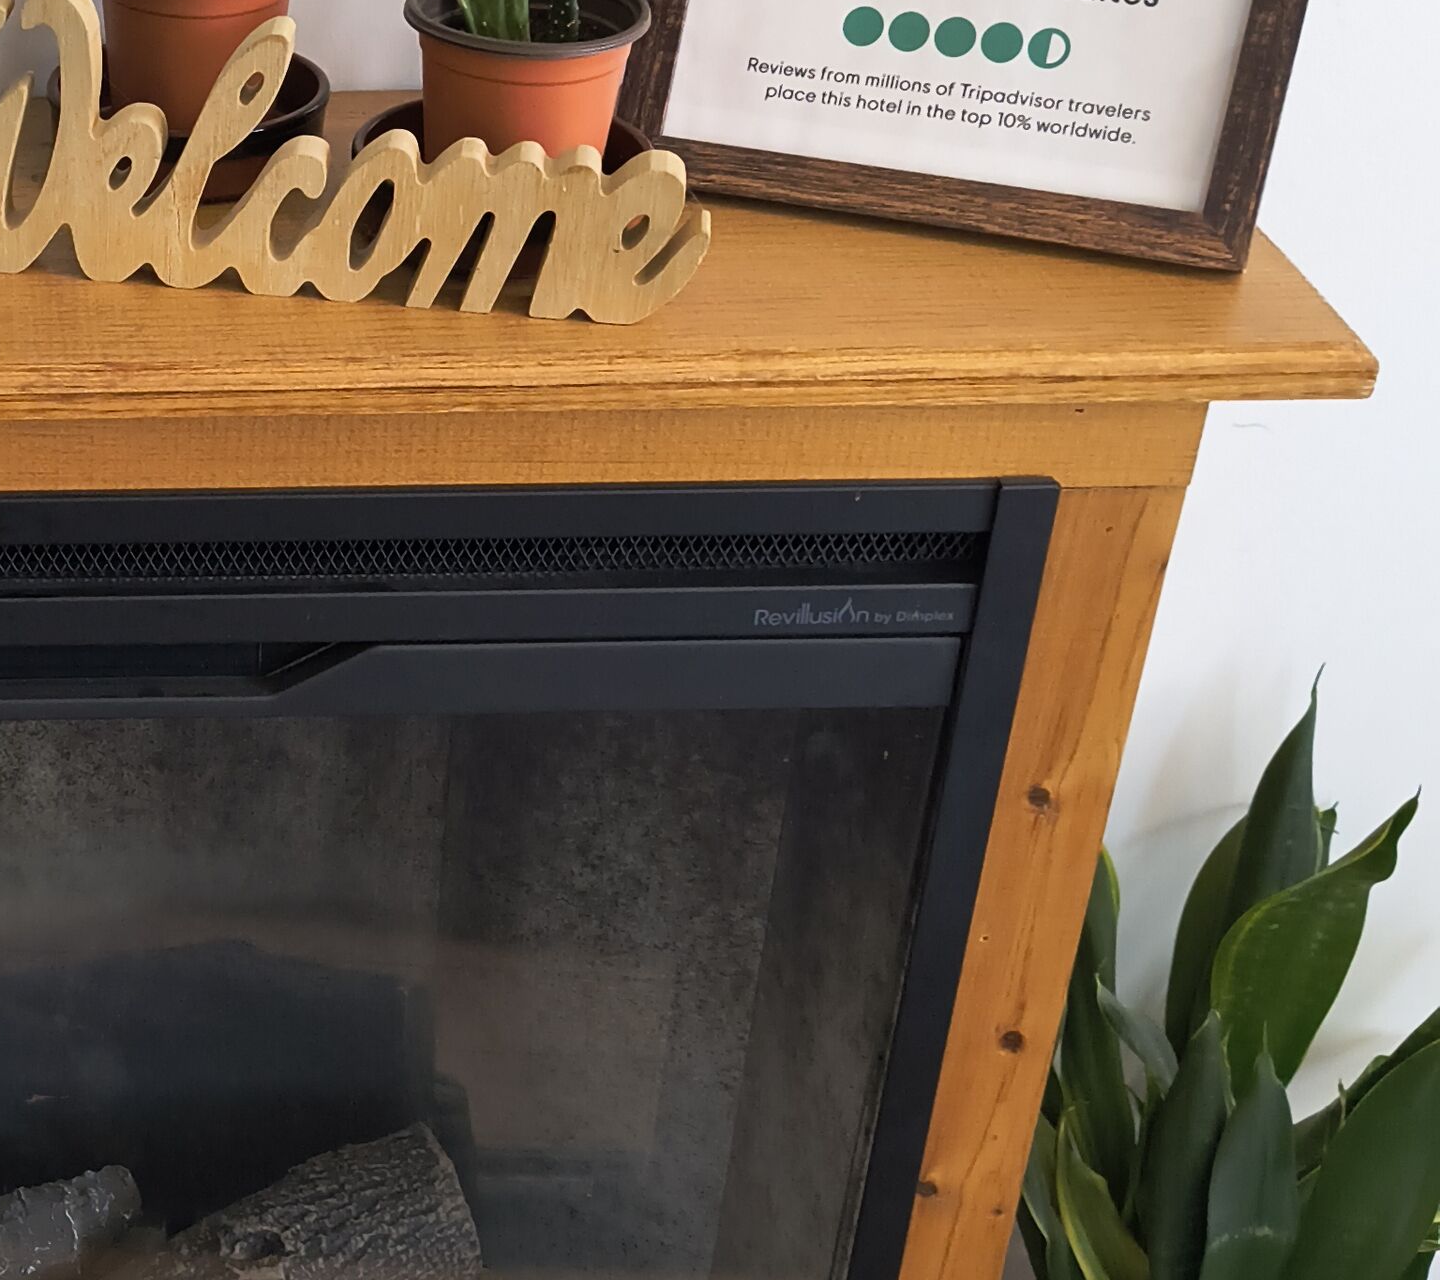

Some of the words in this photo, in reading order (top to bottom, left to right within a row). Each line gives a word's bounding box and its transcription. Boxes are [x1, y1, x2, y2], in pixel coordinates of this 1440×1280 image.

[746, 56, 816, 81] Reviews
[819, 65, 861, 86] from
[864, 73, 932, 95] millions
[935, 81, 957, 98] of
[959, 82, 1065, 112] Tripadvisor
[1067, 97, 1153, 123] travelers
[763, 83, 817, 104] place
[820, 90, 852, 109] this
[855, 94, 903, 116] hotel
[905, 99, 922, 118] in
[925, 103, 957, 122] the
[959, 108, 993, 129] top
[996, 111, 1033, 132] 10%
[1035, 120, 1137, 146] worldwide.
[873, 613, 892, 625] by
